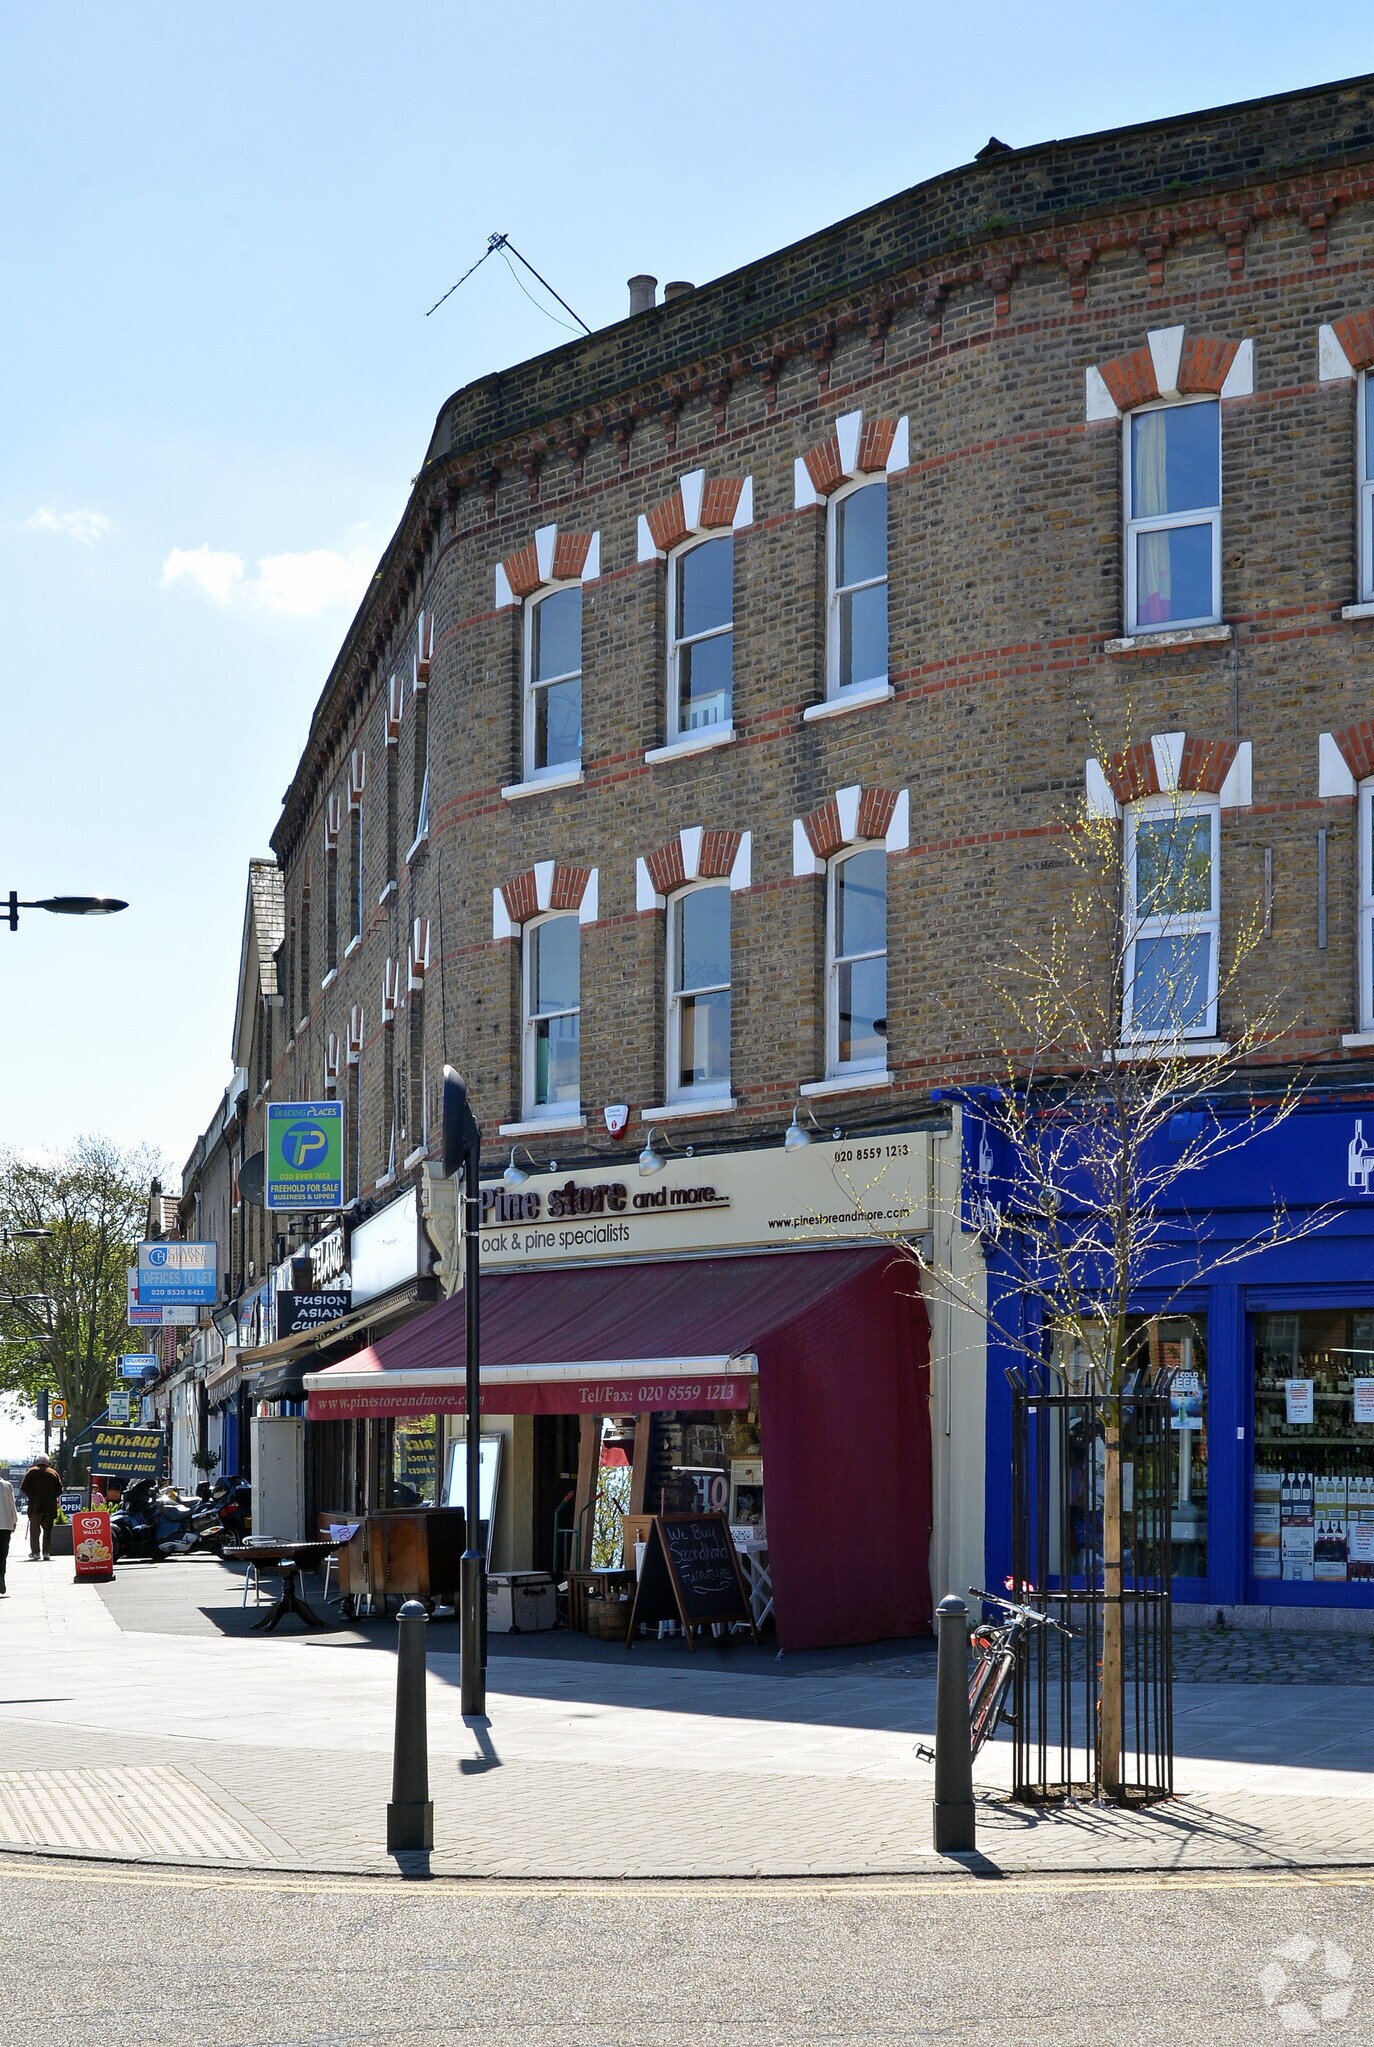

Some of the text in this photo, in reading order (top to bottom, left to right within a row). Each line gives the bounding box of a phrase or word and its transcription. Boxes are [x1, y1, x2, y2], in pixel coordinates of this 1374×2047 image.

[273, 1106, 337, 1117] TRADING PLACES
[834, 1145, 909, 1162] 020 8559 1213
[270, 1183, 339, 1193] FREEHOLD FOR SALE
[479, 1187, 540, 1223] Pine
[547, 1180, 628, 1218] store
[633, 1186, 667, 1209] and
[768, 1208, 910, 1228] www.pinestoreandmore.com
[481, 1223, 630, 1253] oak & pine specialists
[168, 1247, 206, 1255] CLARKE
[143, 1271, 213, 1285] OFFICES TO LET
[293, 1295, 348, 1307] FUSION
[297, 1308, 344, 1318] ASIAN
[578, 1384, 735, 1403] Tel/Fax: 020 8559 1213
[95, 1433, 161, 1448] BATTERIES
[110, 1450, 128, 1458] TYPES
[97, 1462, 156, 1472] WHOLESALE PRICES
[61, 1504, 80, 1512] OPEN
[667, 1524, 720, 1549] We Buy
